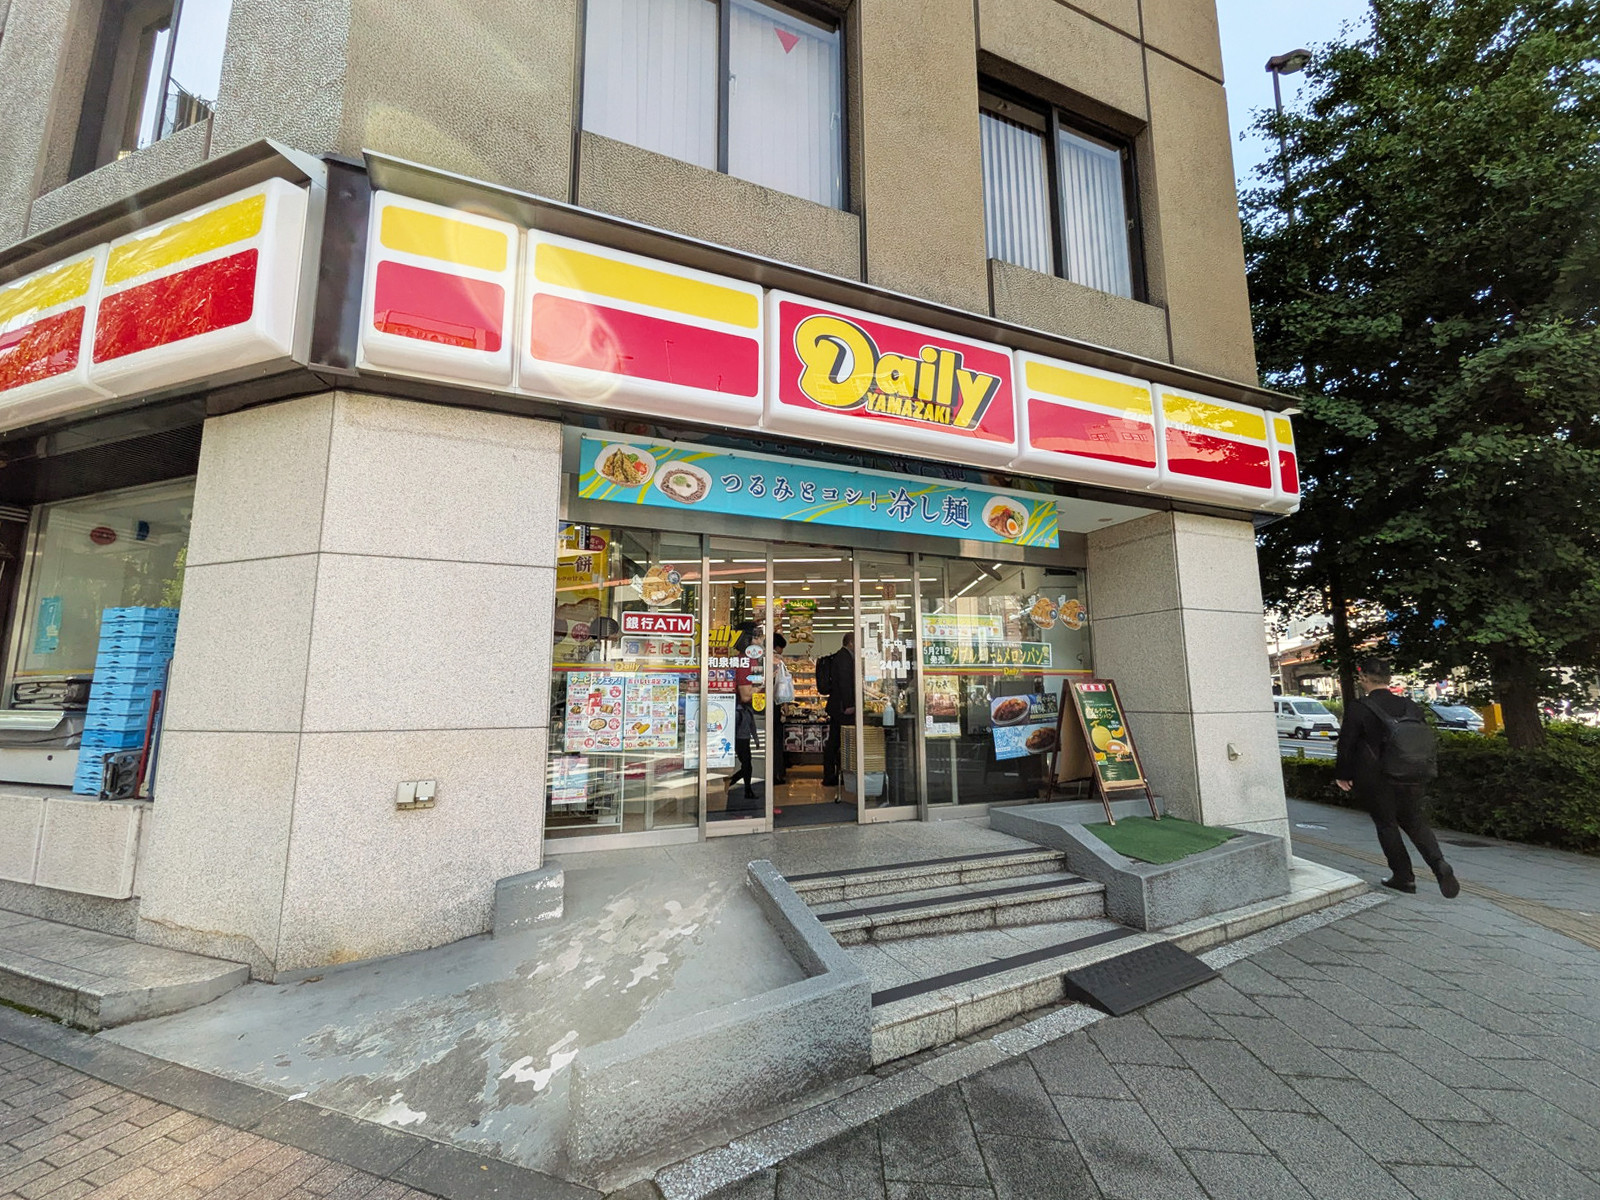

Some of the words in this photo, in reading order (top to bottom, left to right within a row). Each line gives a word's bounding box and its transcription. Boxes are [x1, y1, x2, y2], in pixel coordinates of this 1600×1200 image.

[794, 314, 1001, 431] Daily
[866, 391, 951, 425] YAMAZAKI
[626, 616, 691, 631] 銀行ATM
[924, 646, 951, 656] 5月21日
[951, 647, 1044, 665] ダブルームメロンパン
[615, 662, 640, 672] Daily
